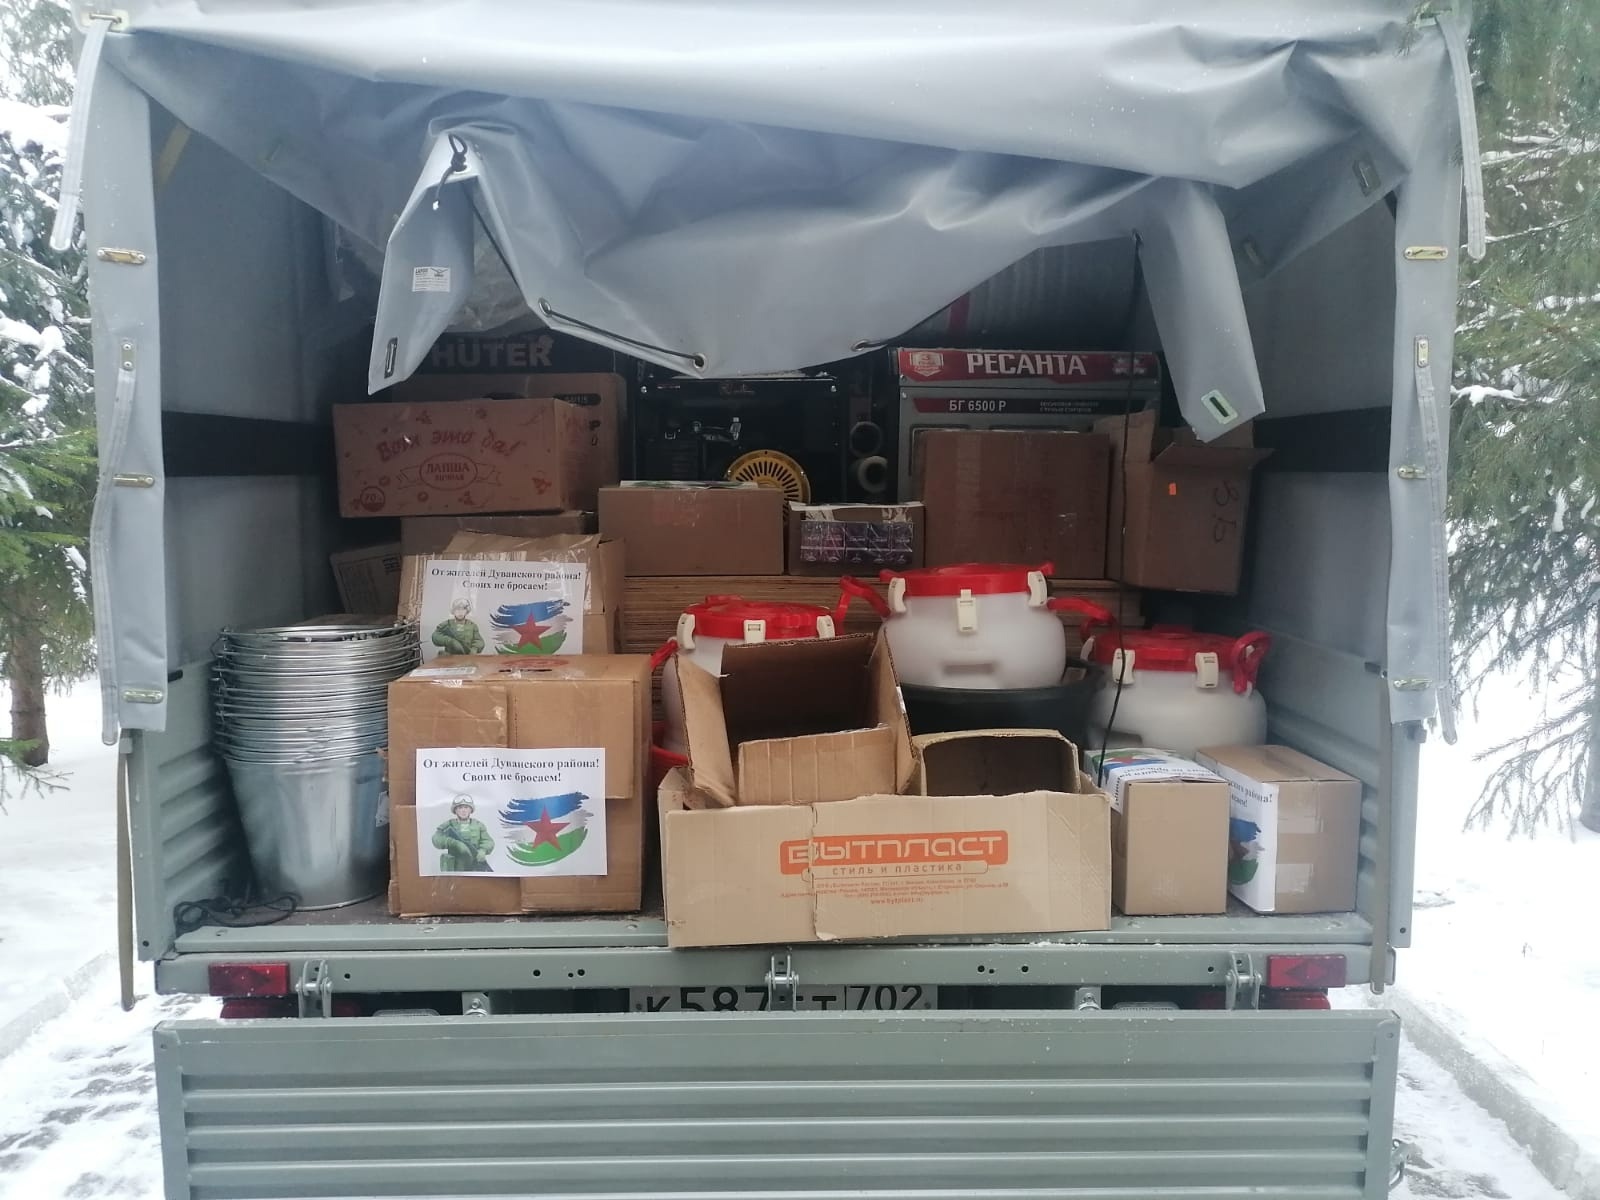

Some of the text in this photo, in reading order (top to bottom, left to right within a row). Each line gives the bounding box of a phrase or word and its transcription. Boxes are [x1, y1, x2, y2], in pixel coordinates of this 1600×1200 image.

[966, 353, 1087, 376] РЕСАНТА
[949, 400, 1006, 412] БГ 6500 Р
[426, 463, 470, 474] ЛАПША
[446, 568, 486, 578] жителей
[487, 568, 542, 579] Дуванского
[544, 570, 582, 582] района!
[462, 580, 548, 592] Своих не бросаем!
[423, 758, 600, 772] От жителей Дуванского района!
[462, 771, 562, 784] Своих не бросаем!
[832, 862, 963, 876] стиль и пластика
